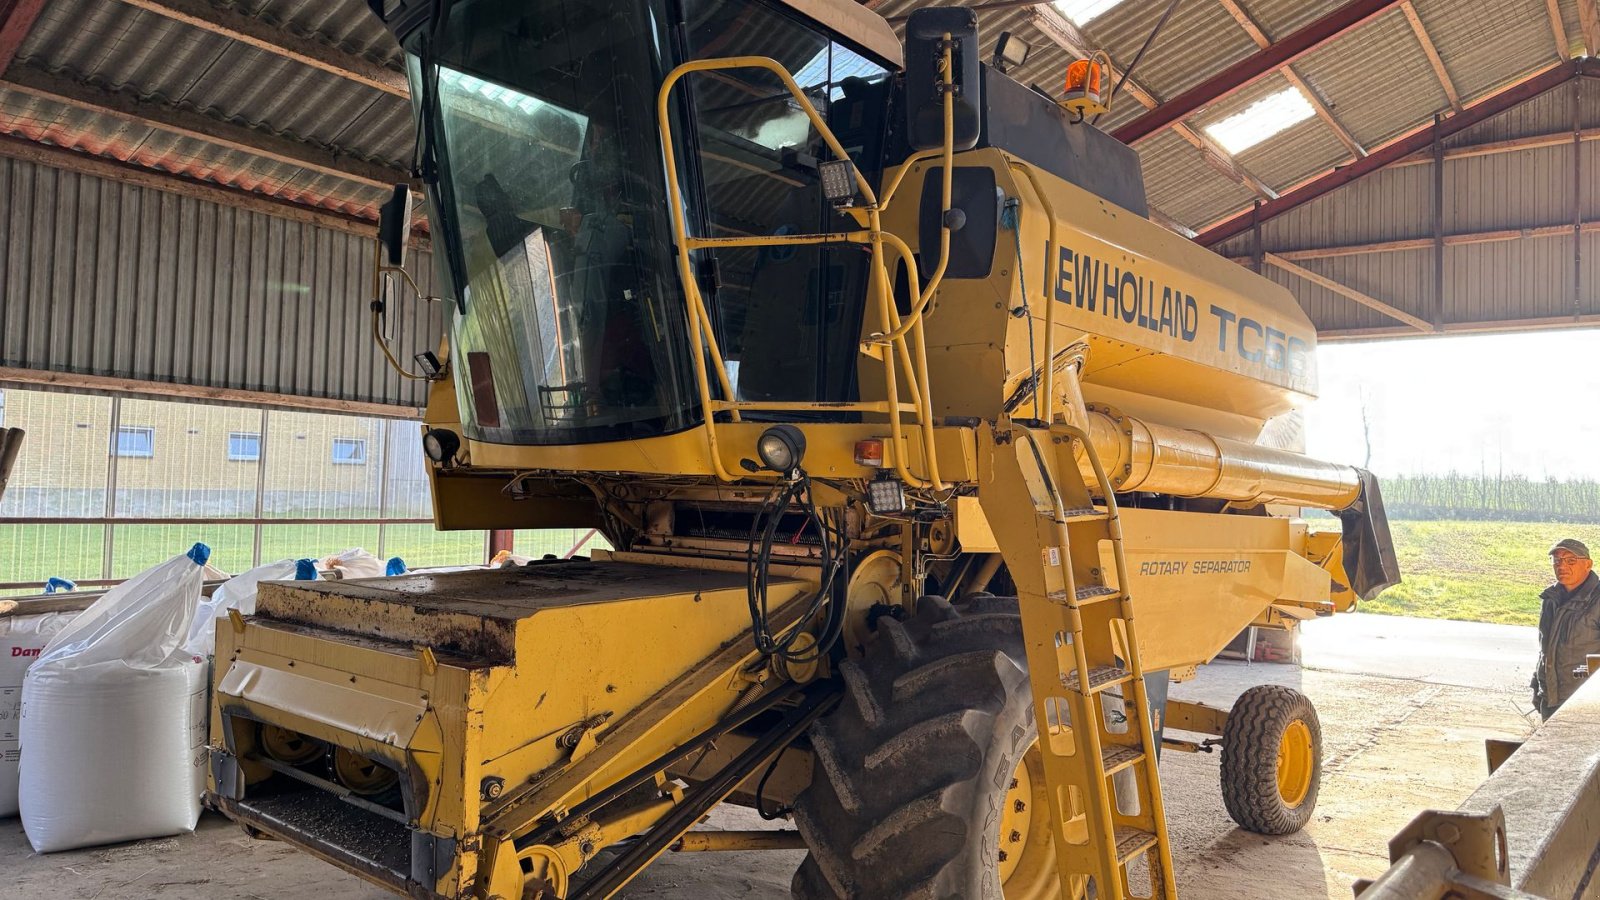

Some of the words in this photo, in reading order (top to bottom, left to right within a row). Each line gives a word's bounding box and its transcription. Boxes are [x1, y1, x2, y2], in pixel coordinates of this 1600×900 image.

[1103, 262, 1198, 343] HOLLAND
[1140, 561, 1188, 576] ROTARY
[1192, 560, 1251, 575] SEPARATOR
